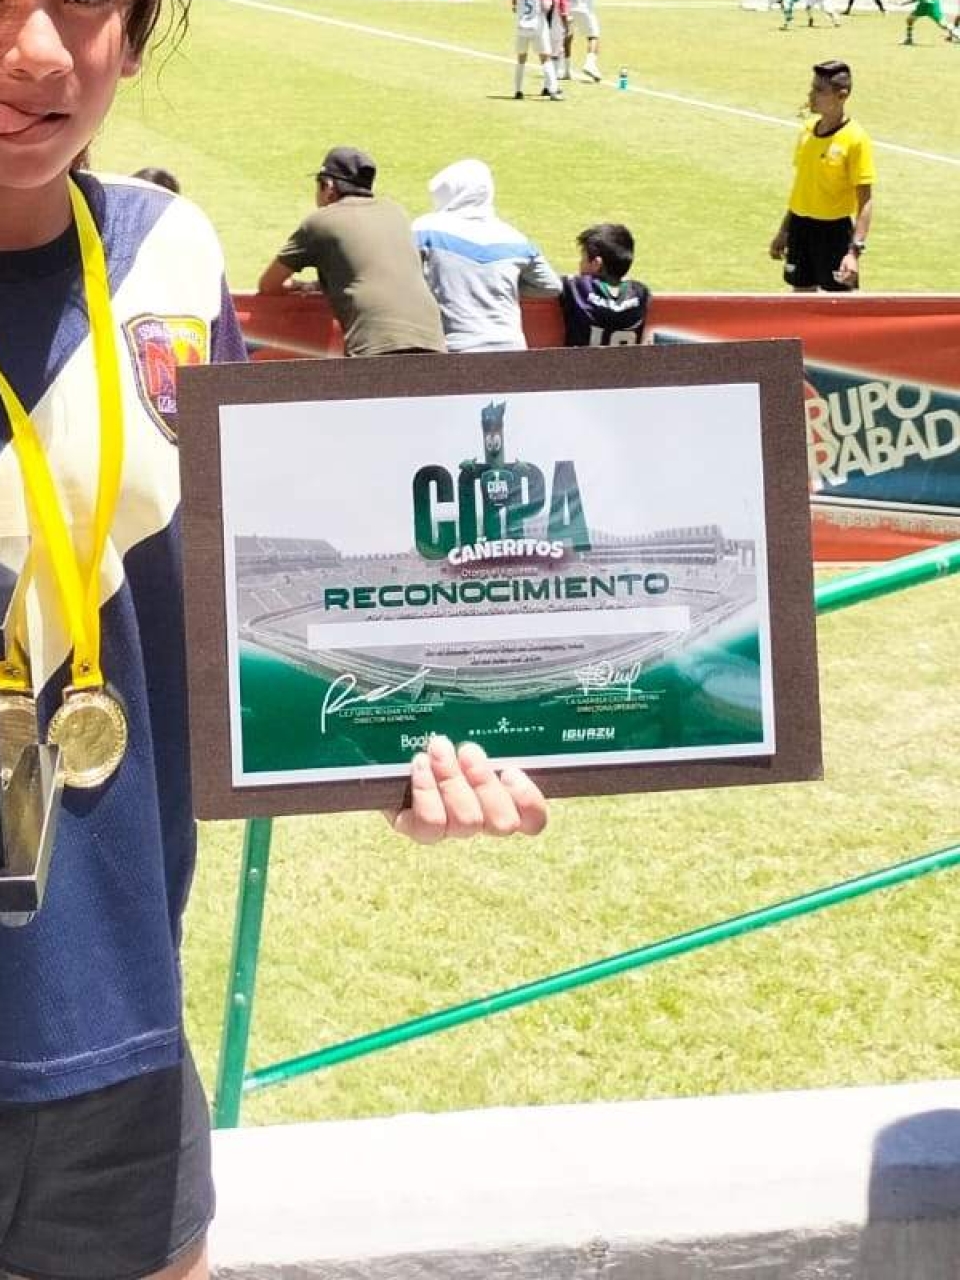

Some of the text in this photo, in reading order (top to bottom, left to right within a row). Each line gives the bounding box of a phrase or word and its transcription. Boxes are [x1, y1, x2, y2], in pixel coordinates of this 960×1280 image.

[803, 381, 933, 452] RUPO
[412, 460, 591, 561] COPA
[447, 537, 564, 566] CAÑERITOS
[323, 572, 671, 612] RECONOCIMIENTO
[562, 727, 616, 742] IGUAZU
